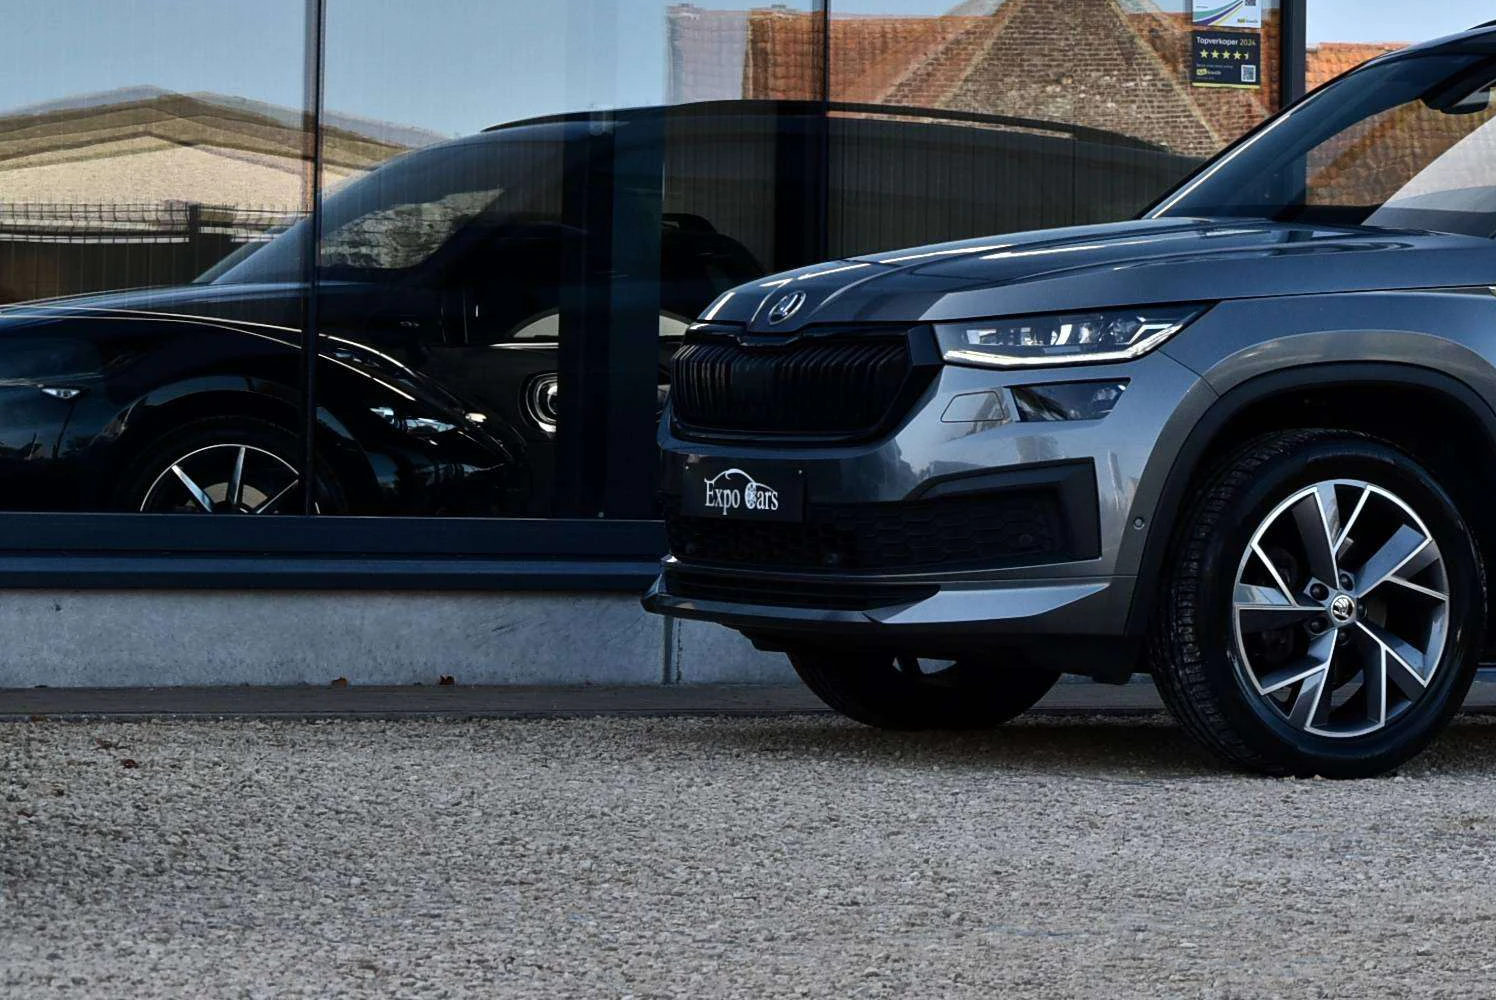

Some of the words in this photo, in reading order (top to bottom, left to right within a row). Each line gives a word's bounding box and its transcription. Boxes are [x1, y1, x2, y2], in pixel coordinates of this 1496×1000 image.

[1196, 36, 1238, 46] Topverkoper
[704, 478, 740, 516] Expo
[744, 481, 779, 511] Cars
